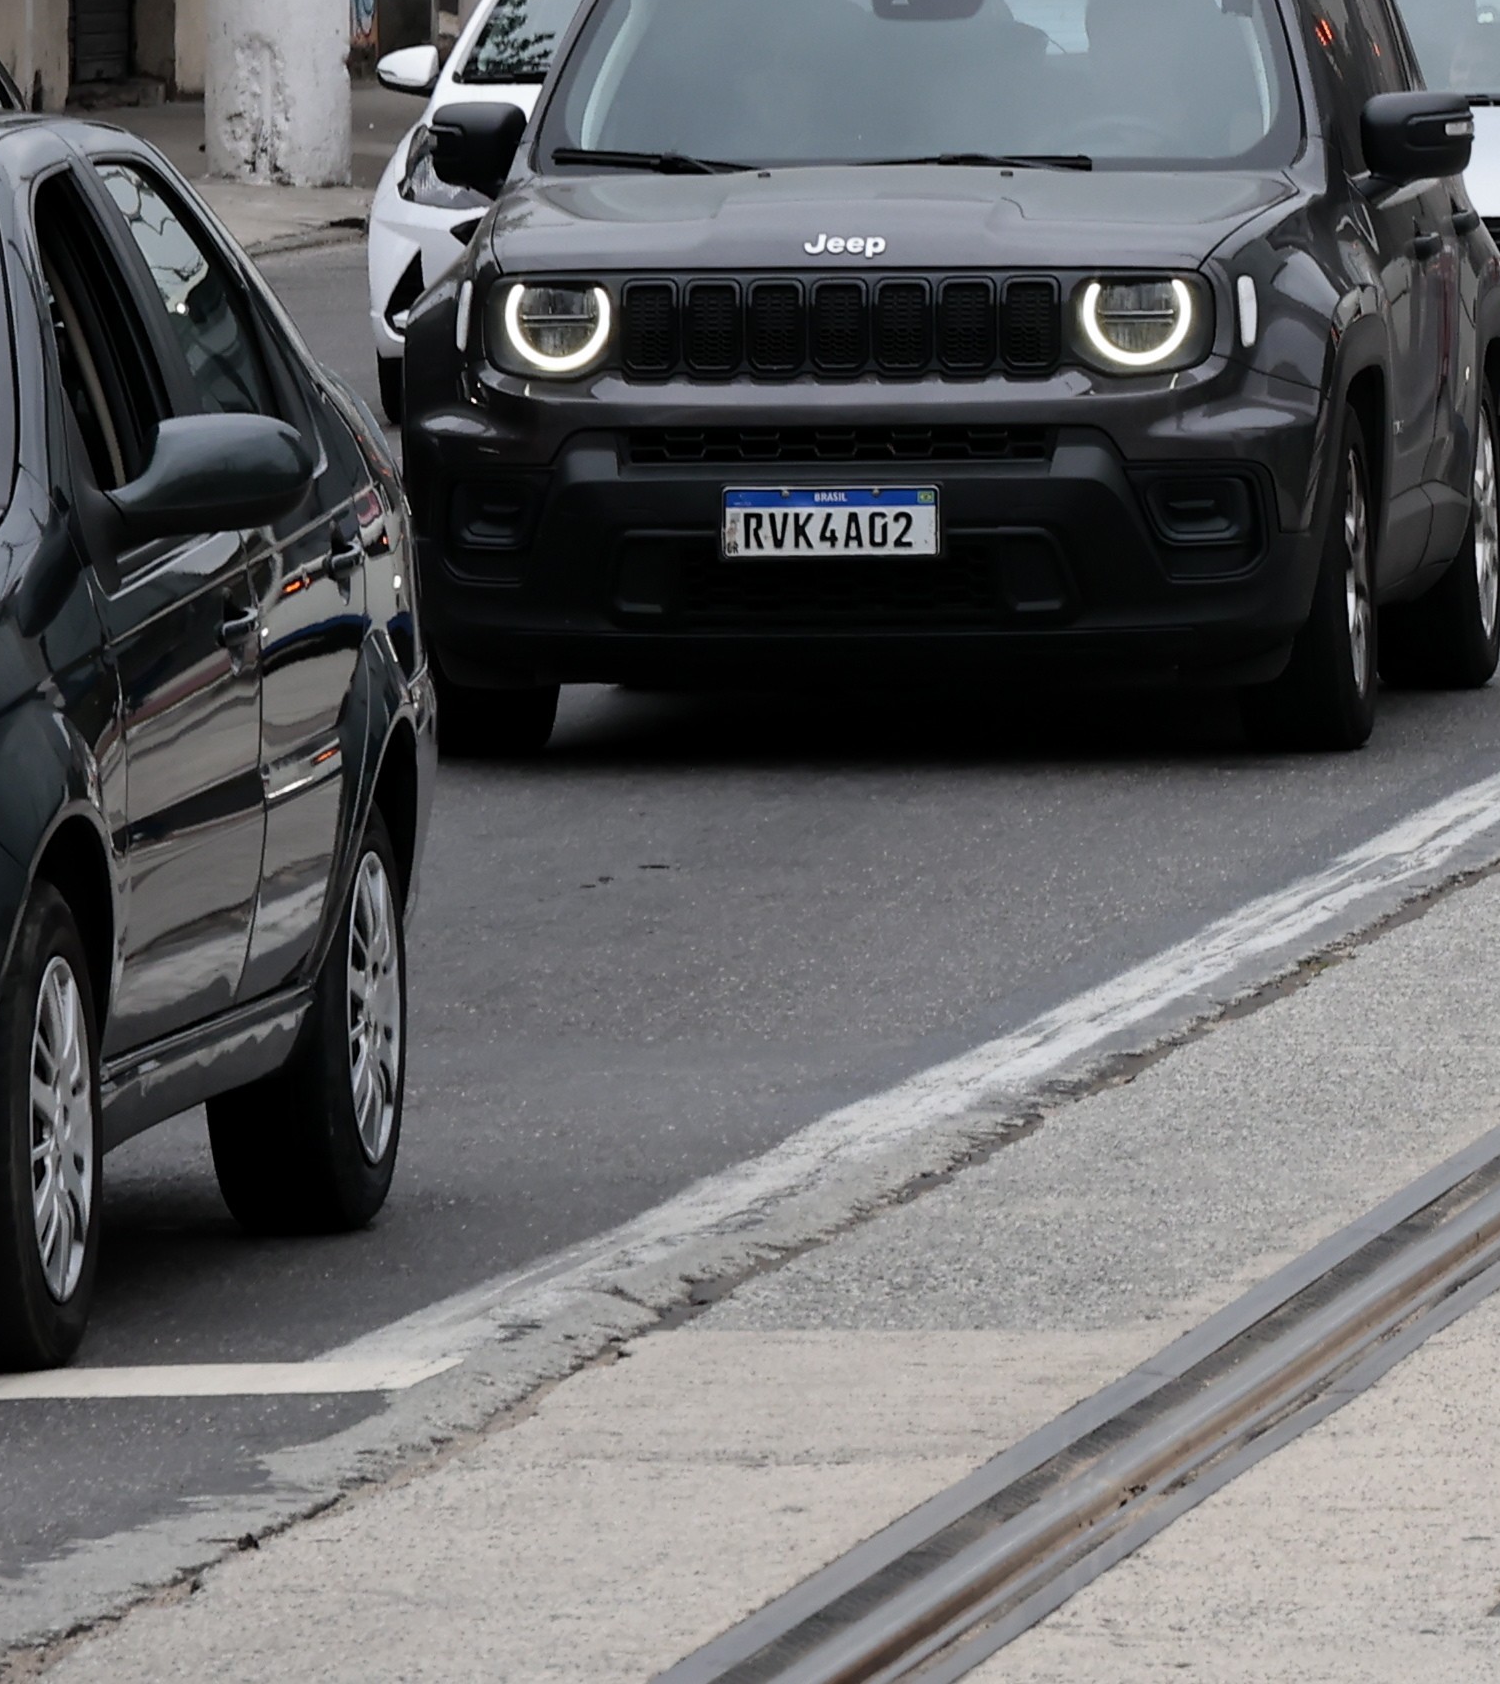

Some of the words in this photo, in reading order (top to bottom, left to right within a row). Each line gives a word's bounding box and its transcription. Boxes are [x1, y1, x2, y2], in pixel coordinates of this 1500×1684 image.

[804, 233, 886, 258] Jeep
[813, 491, 848, 503] BRASIL
[743, 512, 914, 549] RVK4A02
